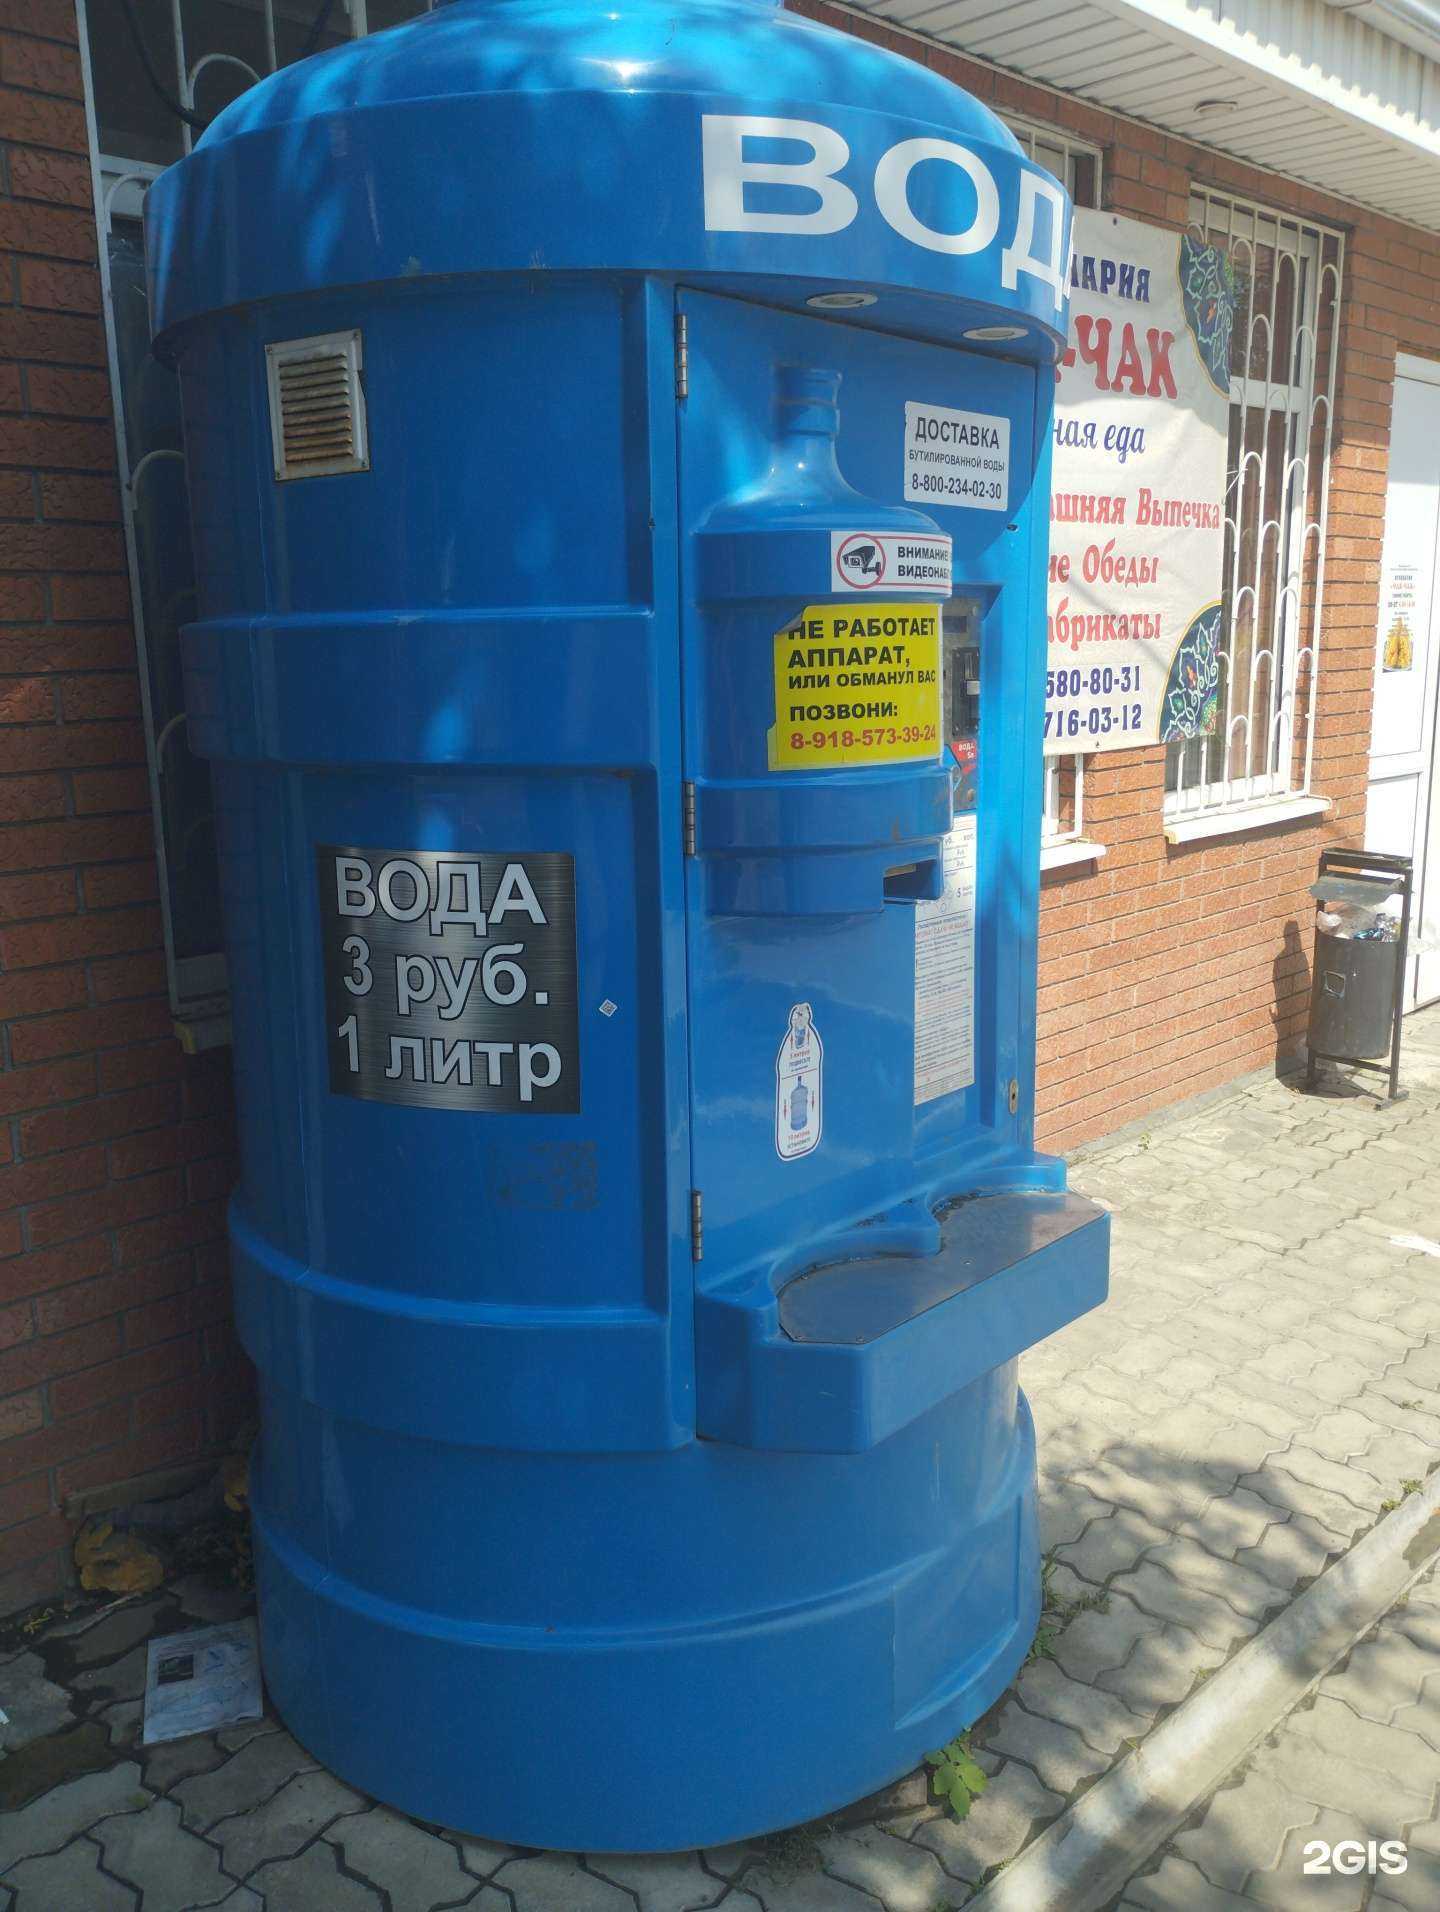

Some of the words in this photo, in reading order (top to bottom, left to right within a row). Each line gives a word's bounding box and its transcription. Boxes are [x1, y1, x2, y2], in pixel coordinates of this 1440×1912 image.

[702, 115, 1076, 312] ВОД
[1055, 315, 1178, 399] -ЧАК
[915, 417, 1000, 449] ДОСТАВКА
[1104, 424, 1146, 464] еда
[909, 449, 982, 468] БУТИЛИРОВАННОЙ
[983, 459, 1005, 473] ВОДЫ
[912, 473, 1002, 500] 8-800-234-02-30
[1136, 487, 1220, 529] Выпечка
[897, 546, 949, 562] ВНИМАНИЕ
[1082, 537, 1160, 588] Обеды
[788, 619, 824, 640] НЕ
[833, 617, 936, 639] РАБОТАЕТ
[788, 646, 910, 668] АППАРАТ,
[788, 674, 830, 690] ИЛИ
[836, 670, 914, 688] ОБМАНУЛ
[917, 670, 936, 684] ВАС
[790, 702, 898, 722] ПОЗВОНИ:
[790, 724, 936, 750] 8-918-573-39-24
[335, 856, 548, 937] ВОДА
[342, 934, 373, 997] 3
[395, 943, 550, 1020] руб.
[337, 1014, 361, 1073] 1
[385, 1034, 563, 1102] литр
